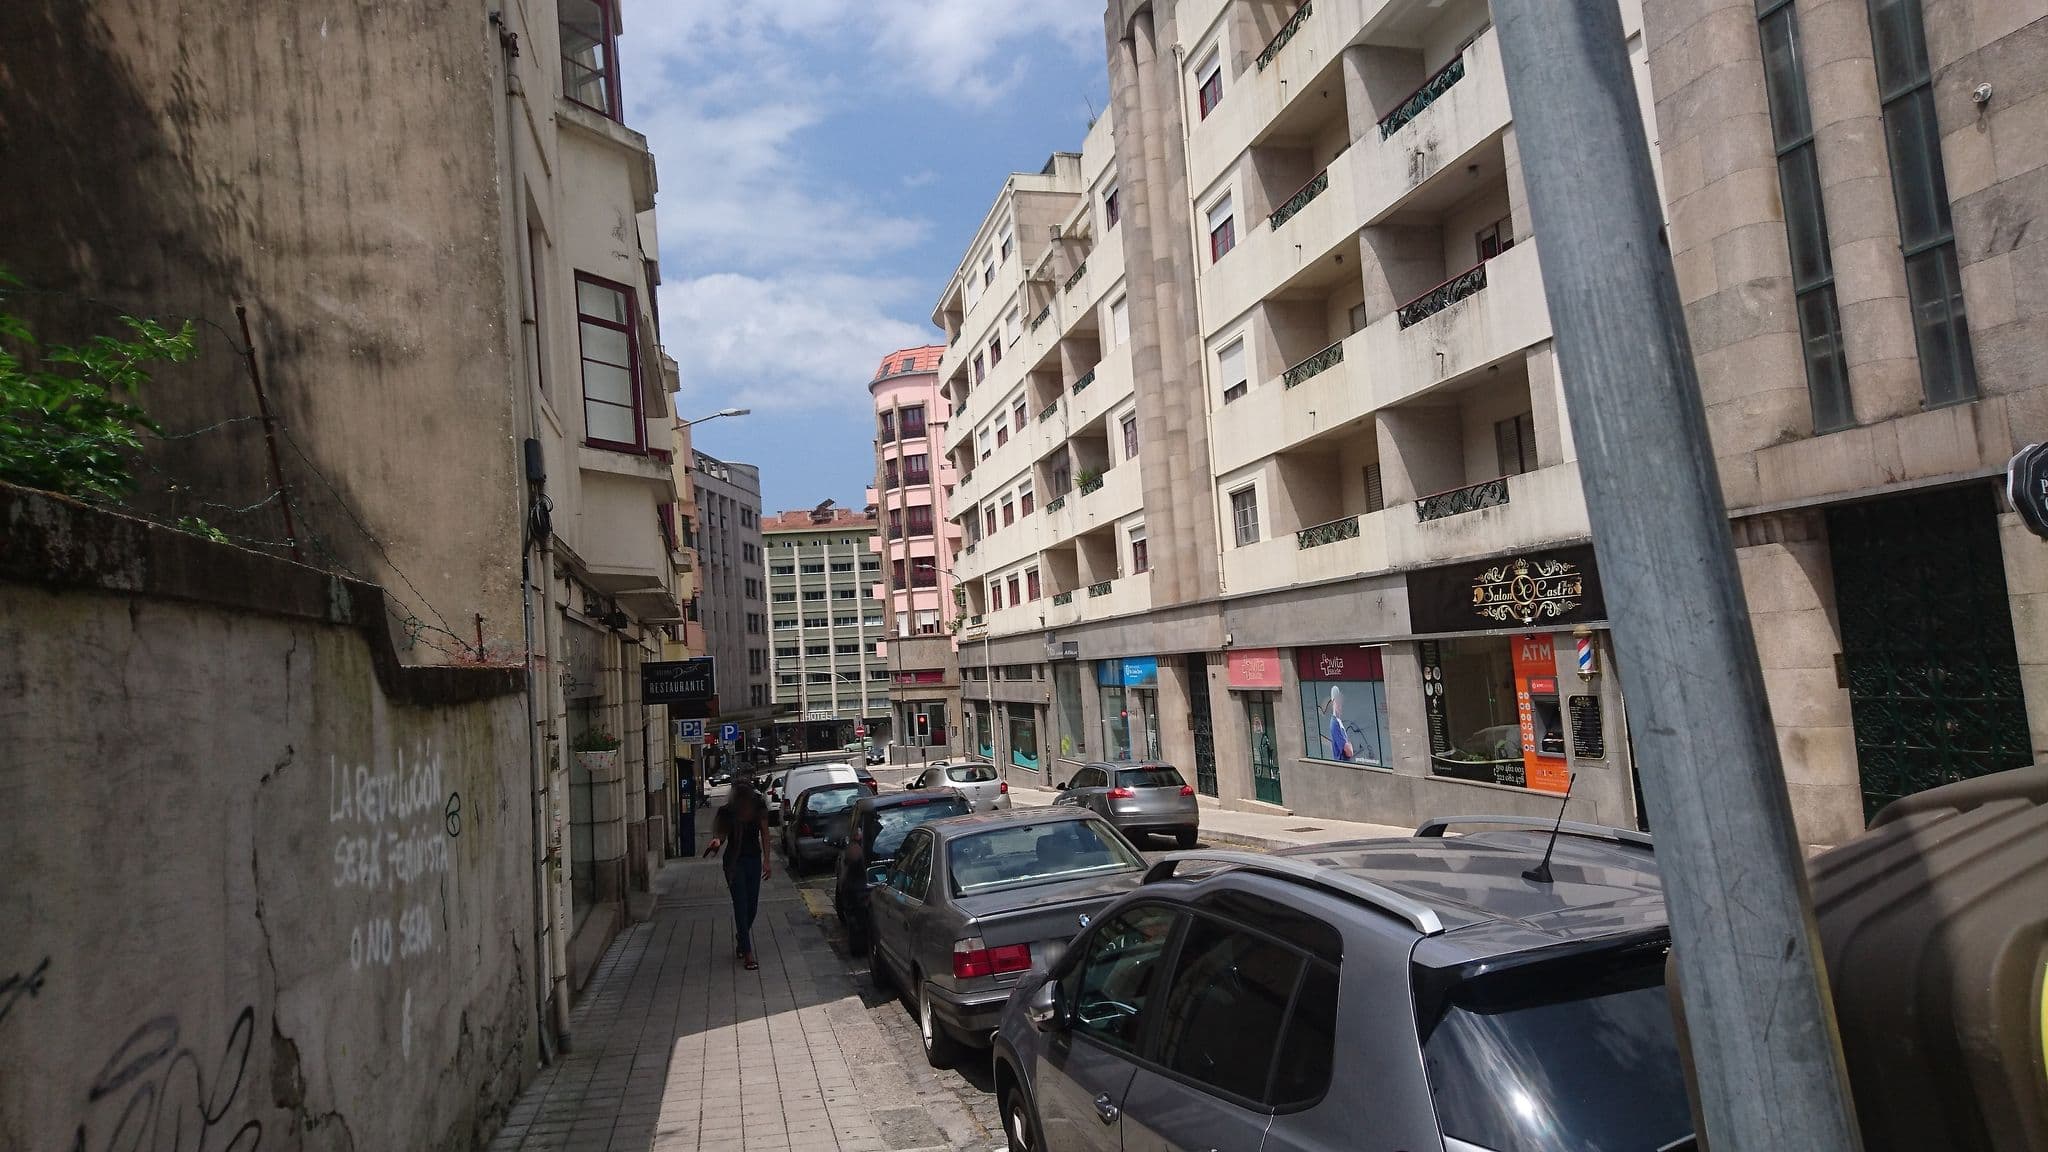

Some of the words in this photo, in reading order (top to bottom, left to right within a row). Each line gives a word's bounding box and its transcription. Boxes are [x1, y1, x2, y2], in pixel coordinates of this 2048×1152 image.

[1484, 585, 1513, 602] Salon
[1536, 580, 1574, 598] Castro
[1522, 644, 1552, 661] ATM
[649, 679, 705, 694] RESTAURANTE
[724, 725, 735, 740] P
[366, 919, 393, 966] NO
